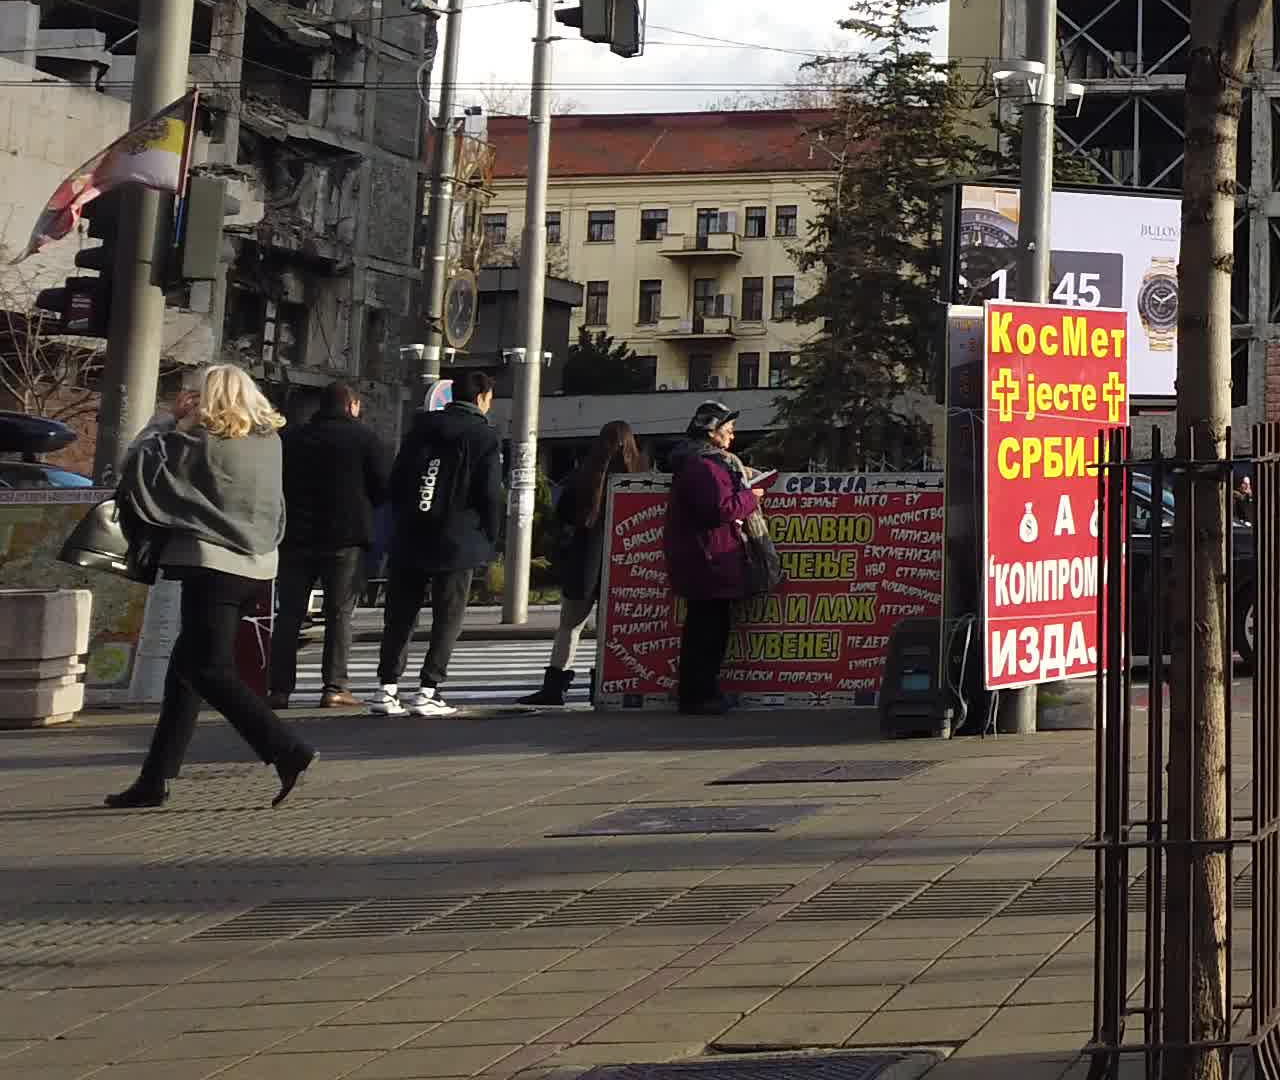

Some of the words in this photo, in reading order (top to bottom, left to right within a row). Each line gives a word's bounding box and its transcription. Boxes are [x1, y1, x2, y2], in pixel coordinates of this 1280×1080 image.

[1140, 223, 1178, 237] BULOV
[1053, 272, 1101, 307] 45
[1025, 373, 1097, 421] јесте
[997, 436, 1111, 480] СРБИЈ
[418, 458, 441, 512] adidas
[786, 476, 868, 494] СРБИЈА
[854, 494, 888, 507] НАТО
[904, 493, 922, 507] ЕУ
[768, 515, 874, 544] СЛАВНО
[1053, 494, 1076, 537] А
[778, 551, 857, 580] ЧЕЊЕ
[786, 595, 809, 624] И
[812, 595, 877, 624] ЛАЖ
[750, 631, 841, 660] УВЕНЕ!
[847, 635, 889, 649] ПЕДЕР
[991, 621, 1097, 680] ИЗДА
[601, 676, 640, 693] СЕКТЕ
